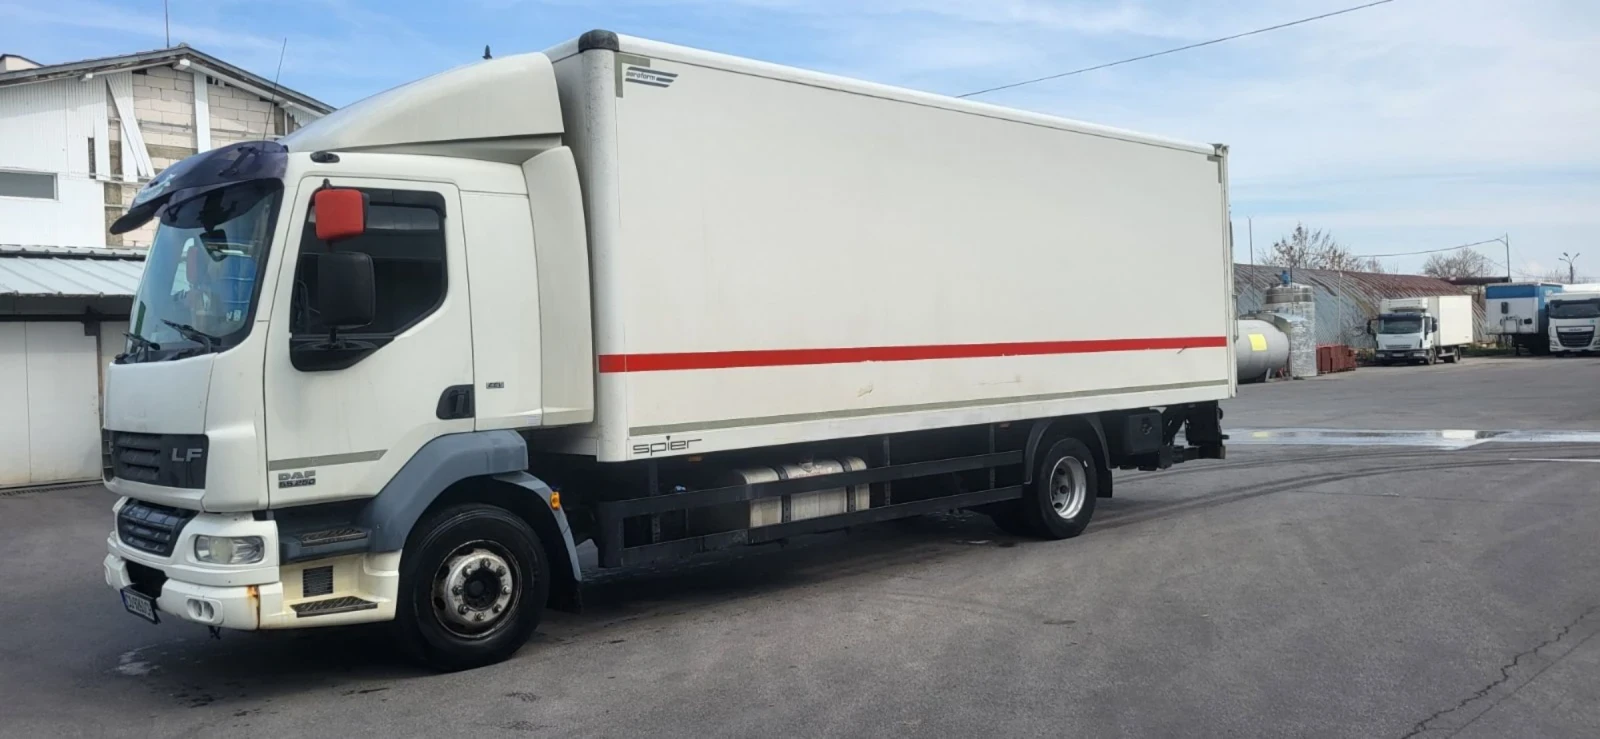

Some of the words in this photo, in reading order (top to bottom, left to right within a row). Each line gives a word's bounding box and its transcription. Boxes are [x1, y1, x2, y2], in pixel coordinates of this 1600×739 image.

[632, 435, 702, 456] spier
[171, 447, 203, 462] LF
[278, 470, 316, 481] DAF
